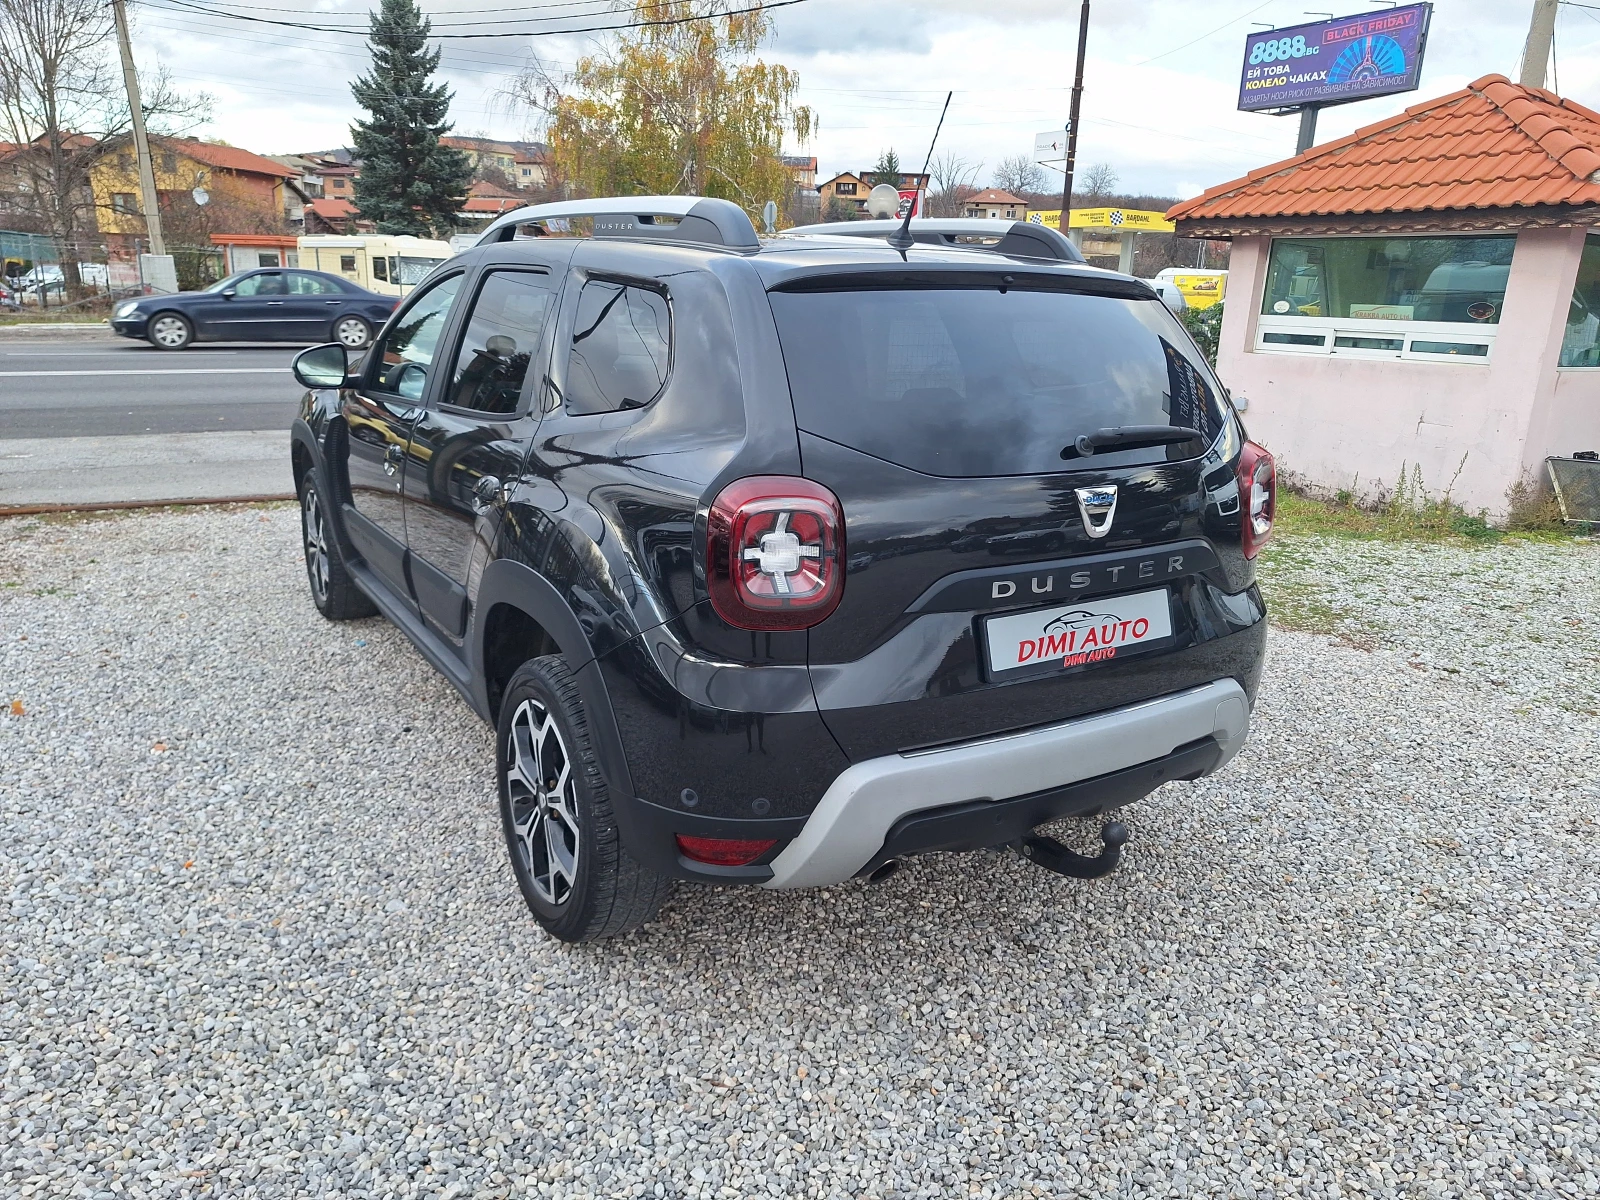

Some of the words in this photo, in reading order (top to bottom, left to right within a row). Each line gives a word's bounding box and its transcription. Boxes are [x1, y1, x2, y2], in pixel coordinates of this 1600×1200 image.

[1326, 25, 1364, 41] BLACK
[1368, 14, 1413, 32] FRIDAY
[1245, 77, 1287, 90] КОЛЕЛО
[1289, 70, 1327, 83] ЧАКАХ
[1247, 66, 1261, 79] ЕЙ
[1263, 64, 1290, 76] ТОВА
[1270, 91, 1288, 100] НОСИ
[1288, 89, 1304, 98] РИСК
[1304, 88, 1313, 97] ОТ
[1351, 81, 1361, 90] НА
[1361, 75, 1408, 89] ЗАВИСИМОСТ
[1126, 214, 1150, 223] BARDAHL
[1355, 311, 1380, 319] KRAKRA
[991, 555, 1185, 599] DUSTER
[1017, 629, 1077, 663] DIMI
[1080, 617, 1149, 650] AUTO
[1063, 653, 1087, 667] DIMI
[1087, 647, 1116, 662] AUTO
